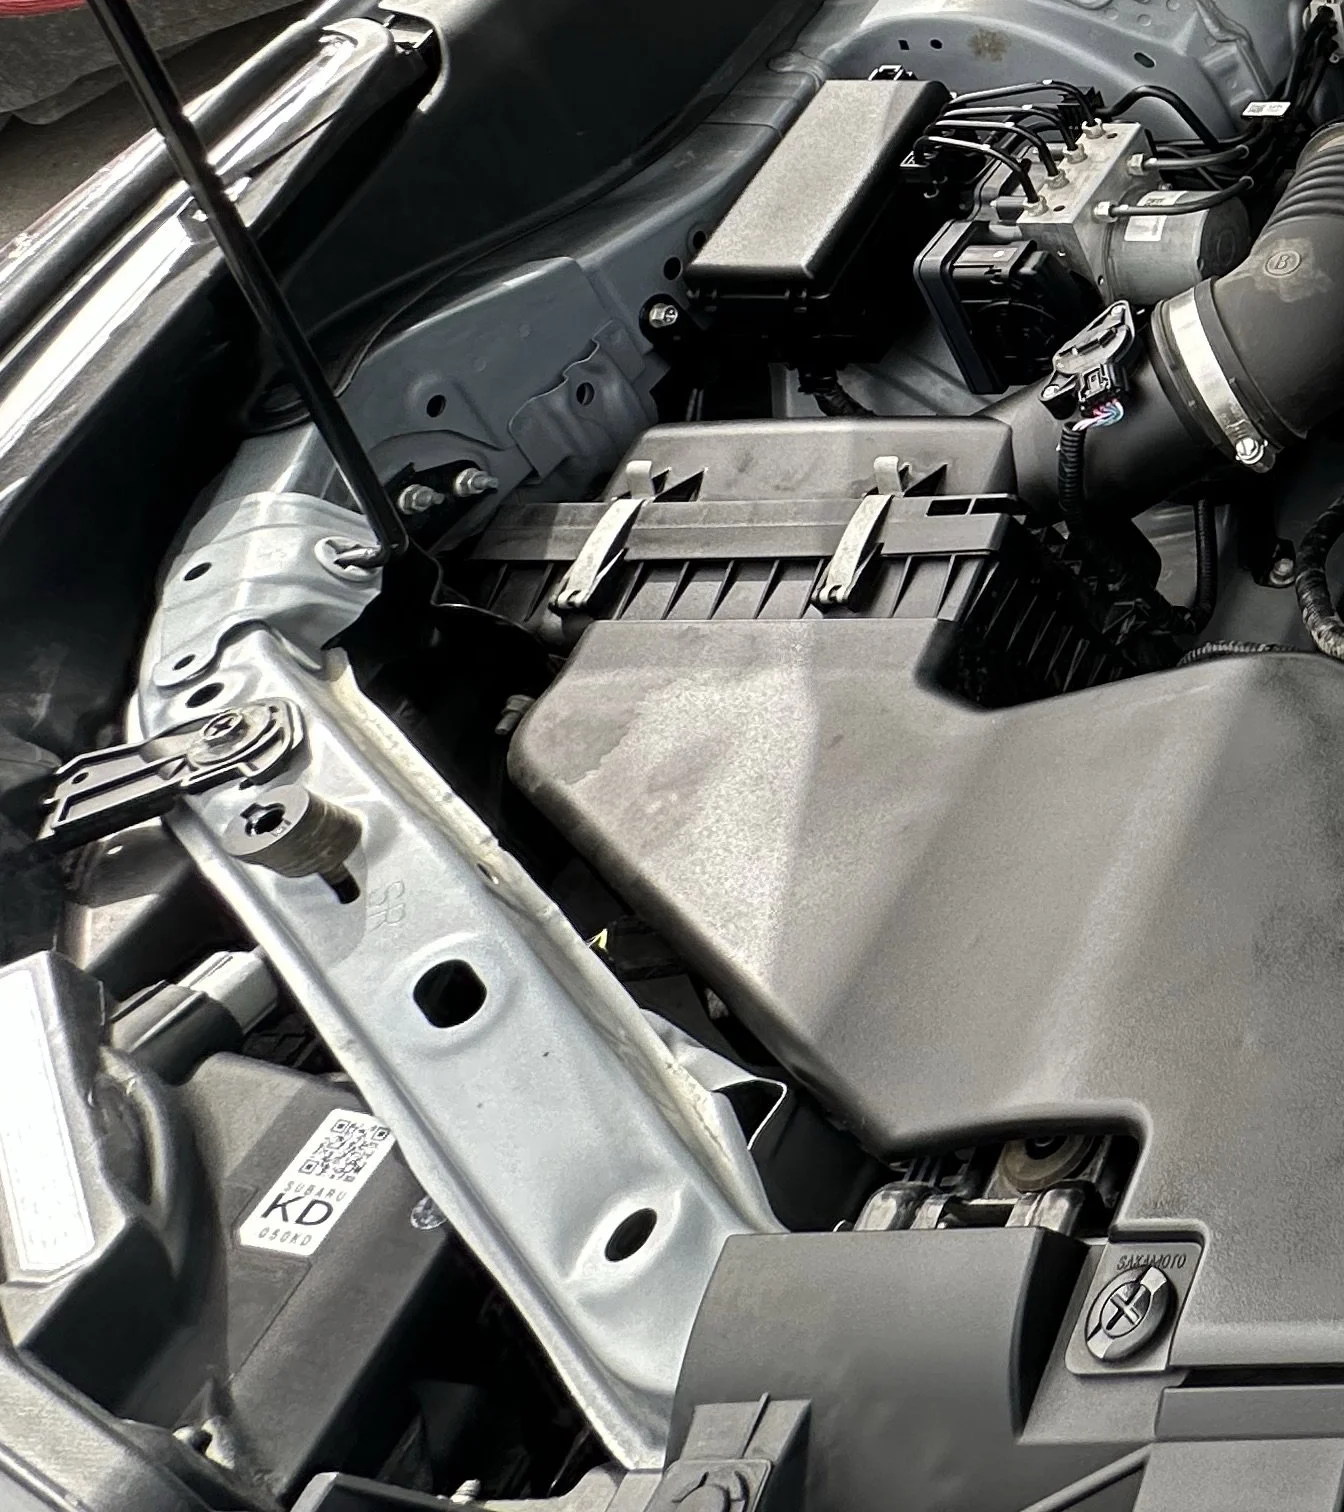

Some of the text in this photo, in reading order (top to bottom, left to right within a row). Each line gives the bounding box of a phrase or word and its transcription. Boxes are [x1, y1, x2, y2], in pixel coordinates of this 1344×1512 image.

[1274, 254, 1291, 271] B
[284, 1180, 347, 1202] SUBARU
[260, 1193, 334, 1226] KD
